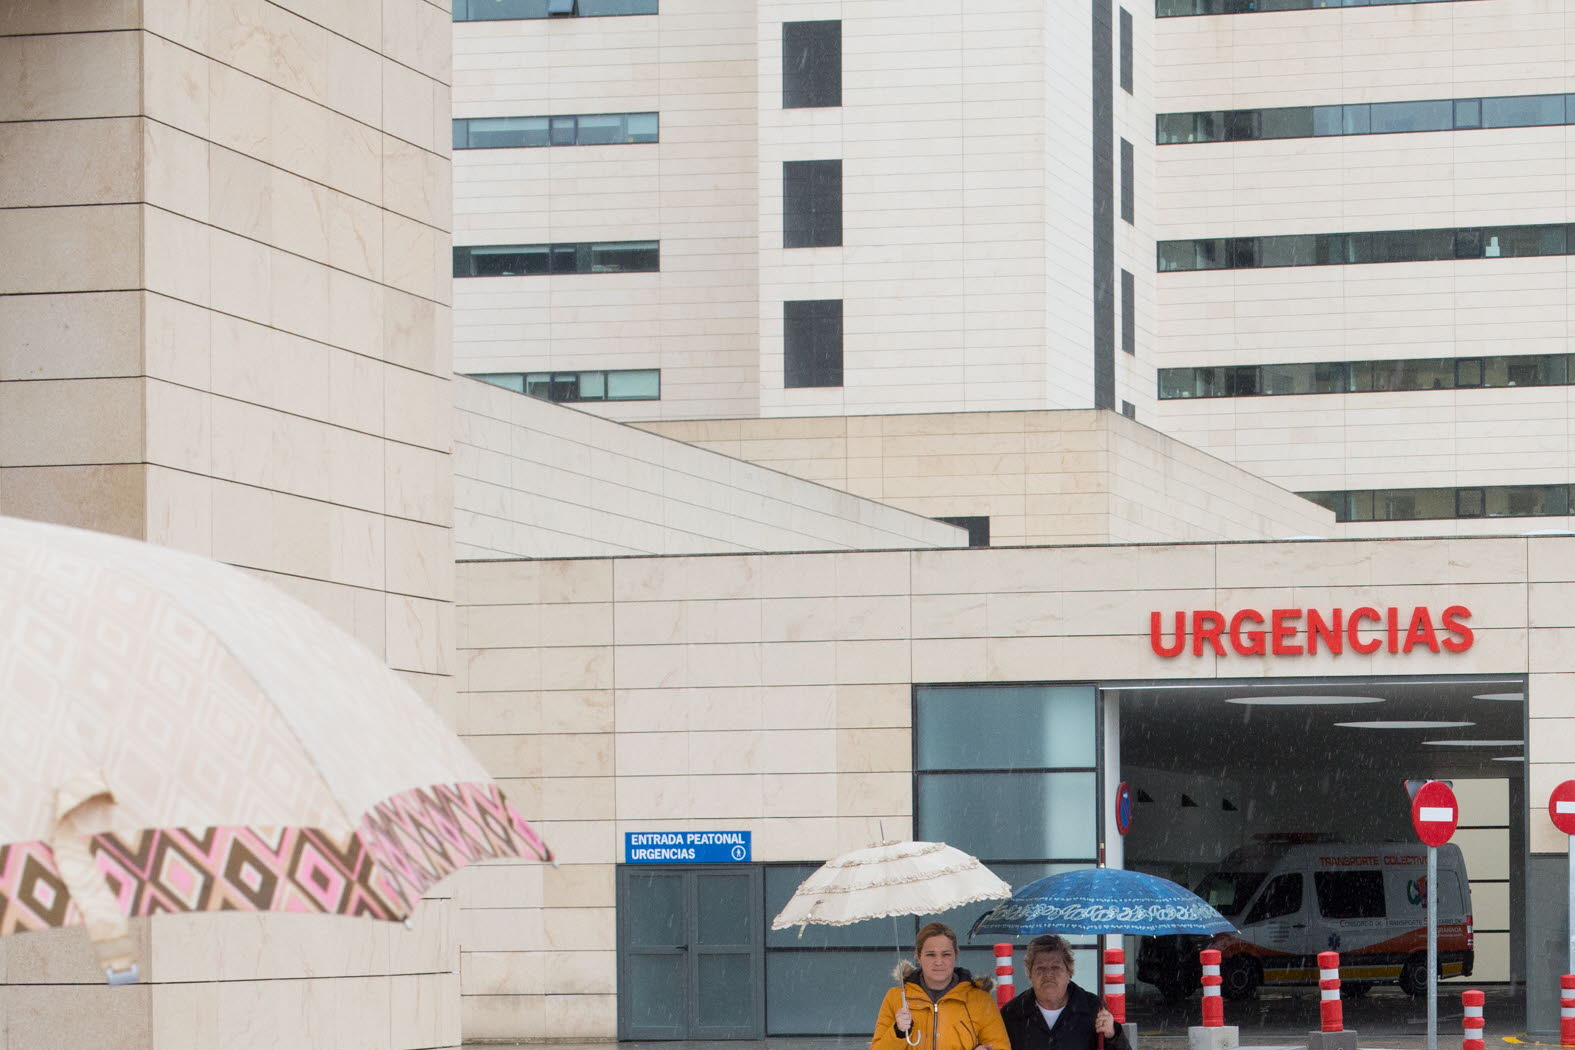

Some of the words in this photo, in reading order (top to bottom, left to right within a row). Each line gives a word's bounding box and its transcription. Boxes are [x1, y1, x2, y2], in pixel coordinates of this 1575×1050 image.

[1150, 605, 1475, 658] URGENCIAS
[631, 834, 684, 845] ENTRADA
[687, 833, 746, 845] PEATONAL
[631, 848, 696, 860] URGENCIAS
[1319, 856, 1379, 867] TRANSPORTE
